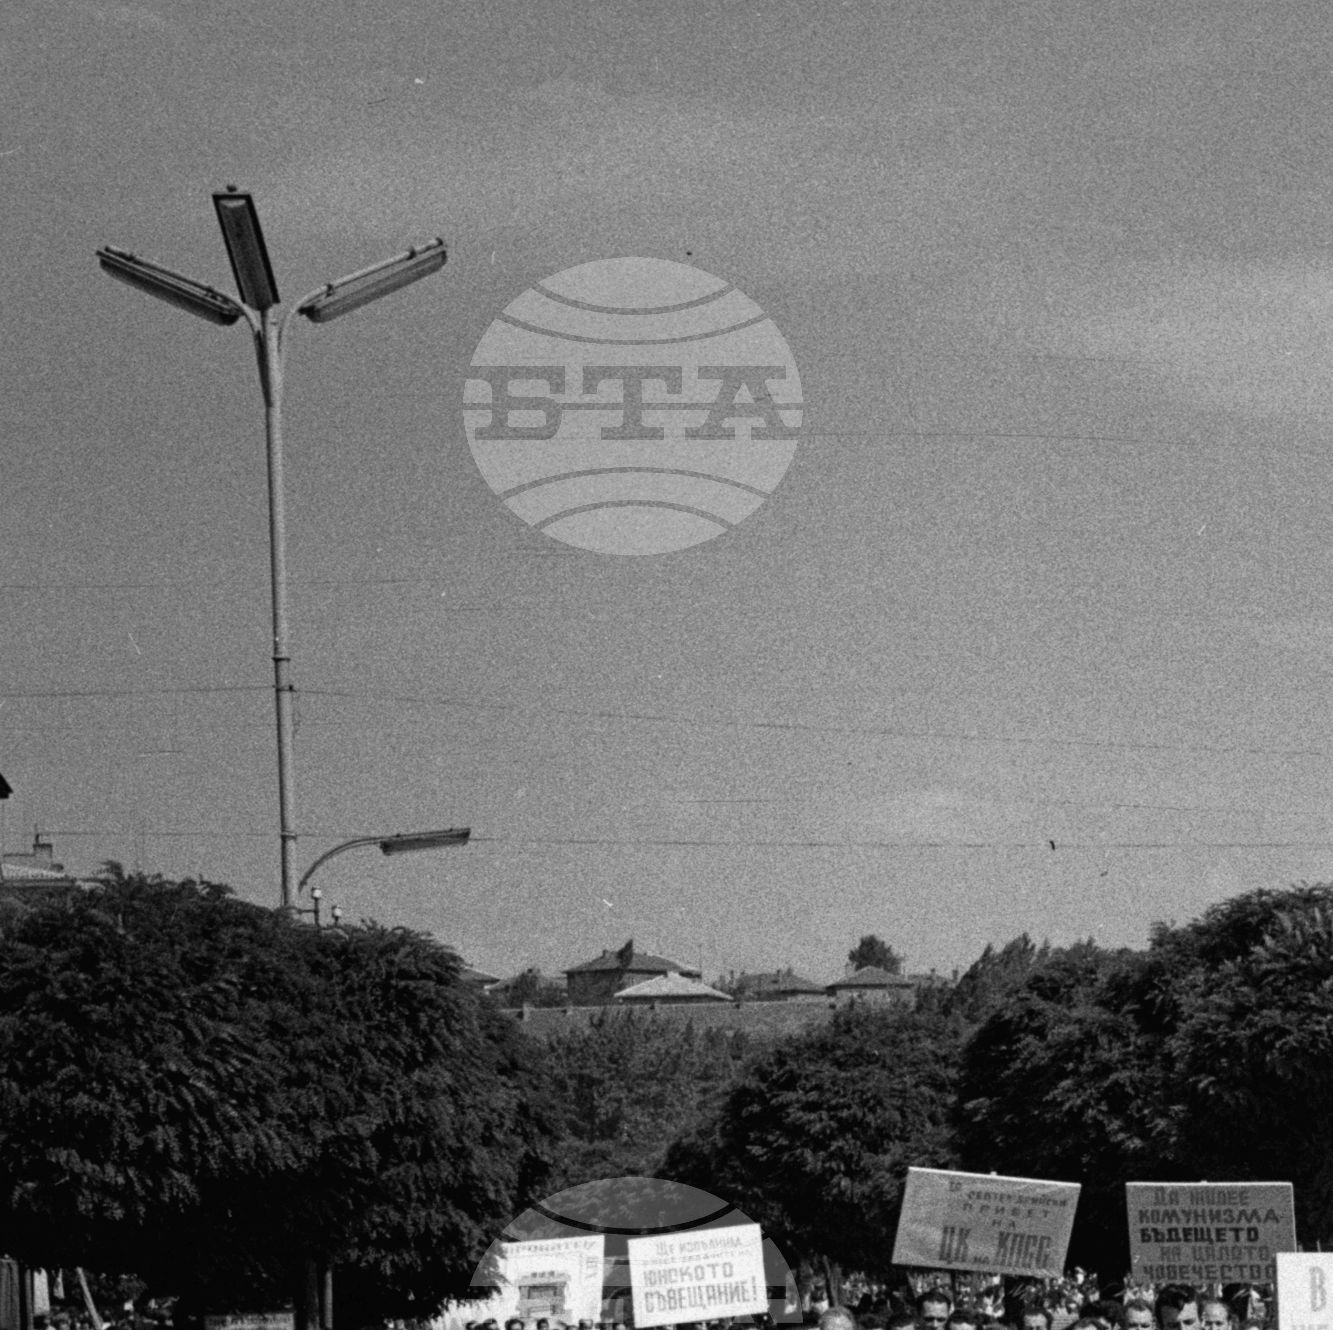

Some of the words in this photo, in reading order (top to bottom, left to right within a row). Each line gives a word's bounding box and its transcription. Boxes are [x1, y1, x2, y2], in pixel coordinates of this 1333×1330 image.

[1154, 1187, 1180, 1206] ДА
[939, 1224, 972, 1265] ЦК
[992, 1230, 1052, 1269] КПСС
[1139, 1226, 1260, 1245] БЪДЕЩЕТО
[1160, 1245, 1181, 1261] НА
[644, 1275, 758, 1314] СЪВЕЩАНИЕ!
[1308, 1265, 1328, 1313] В
